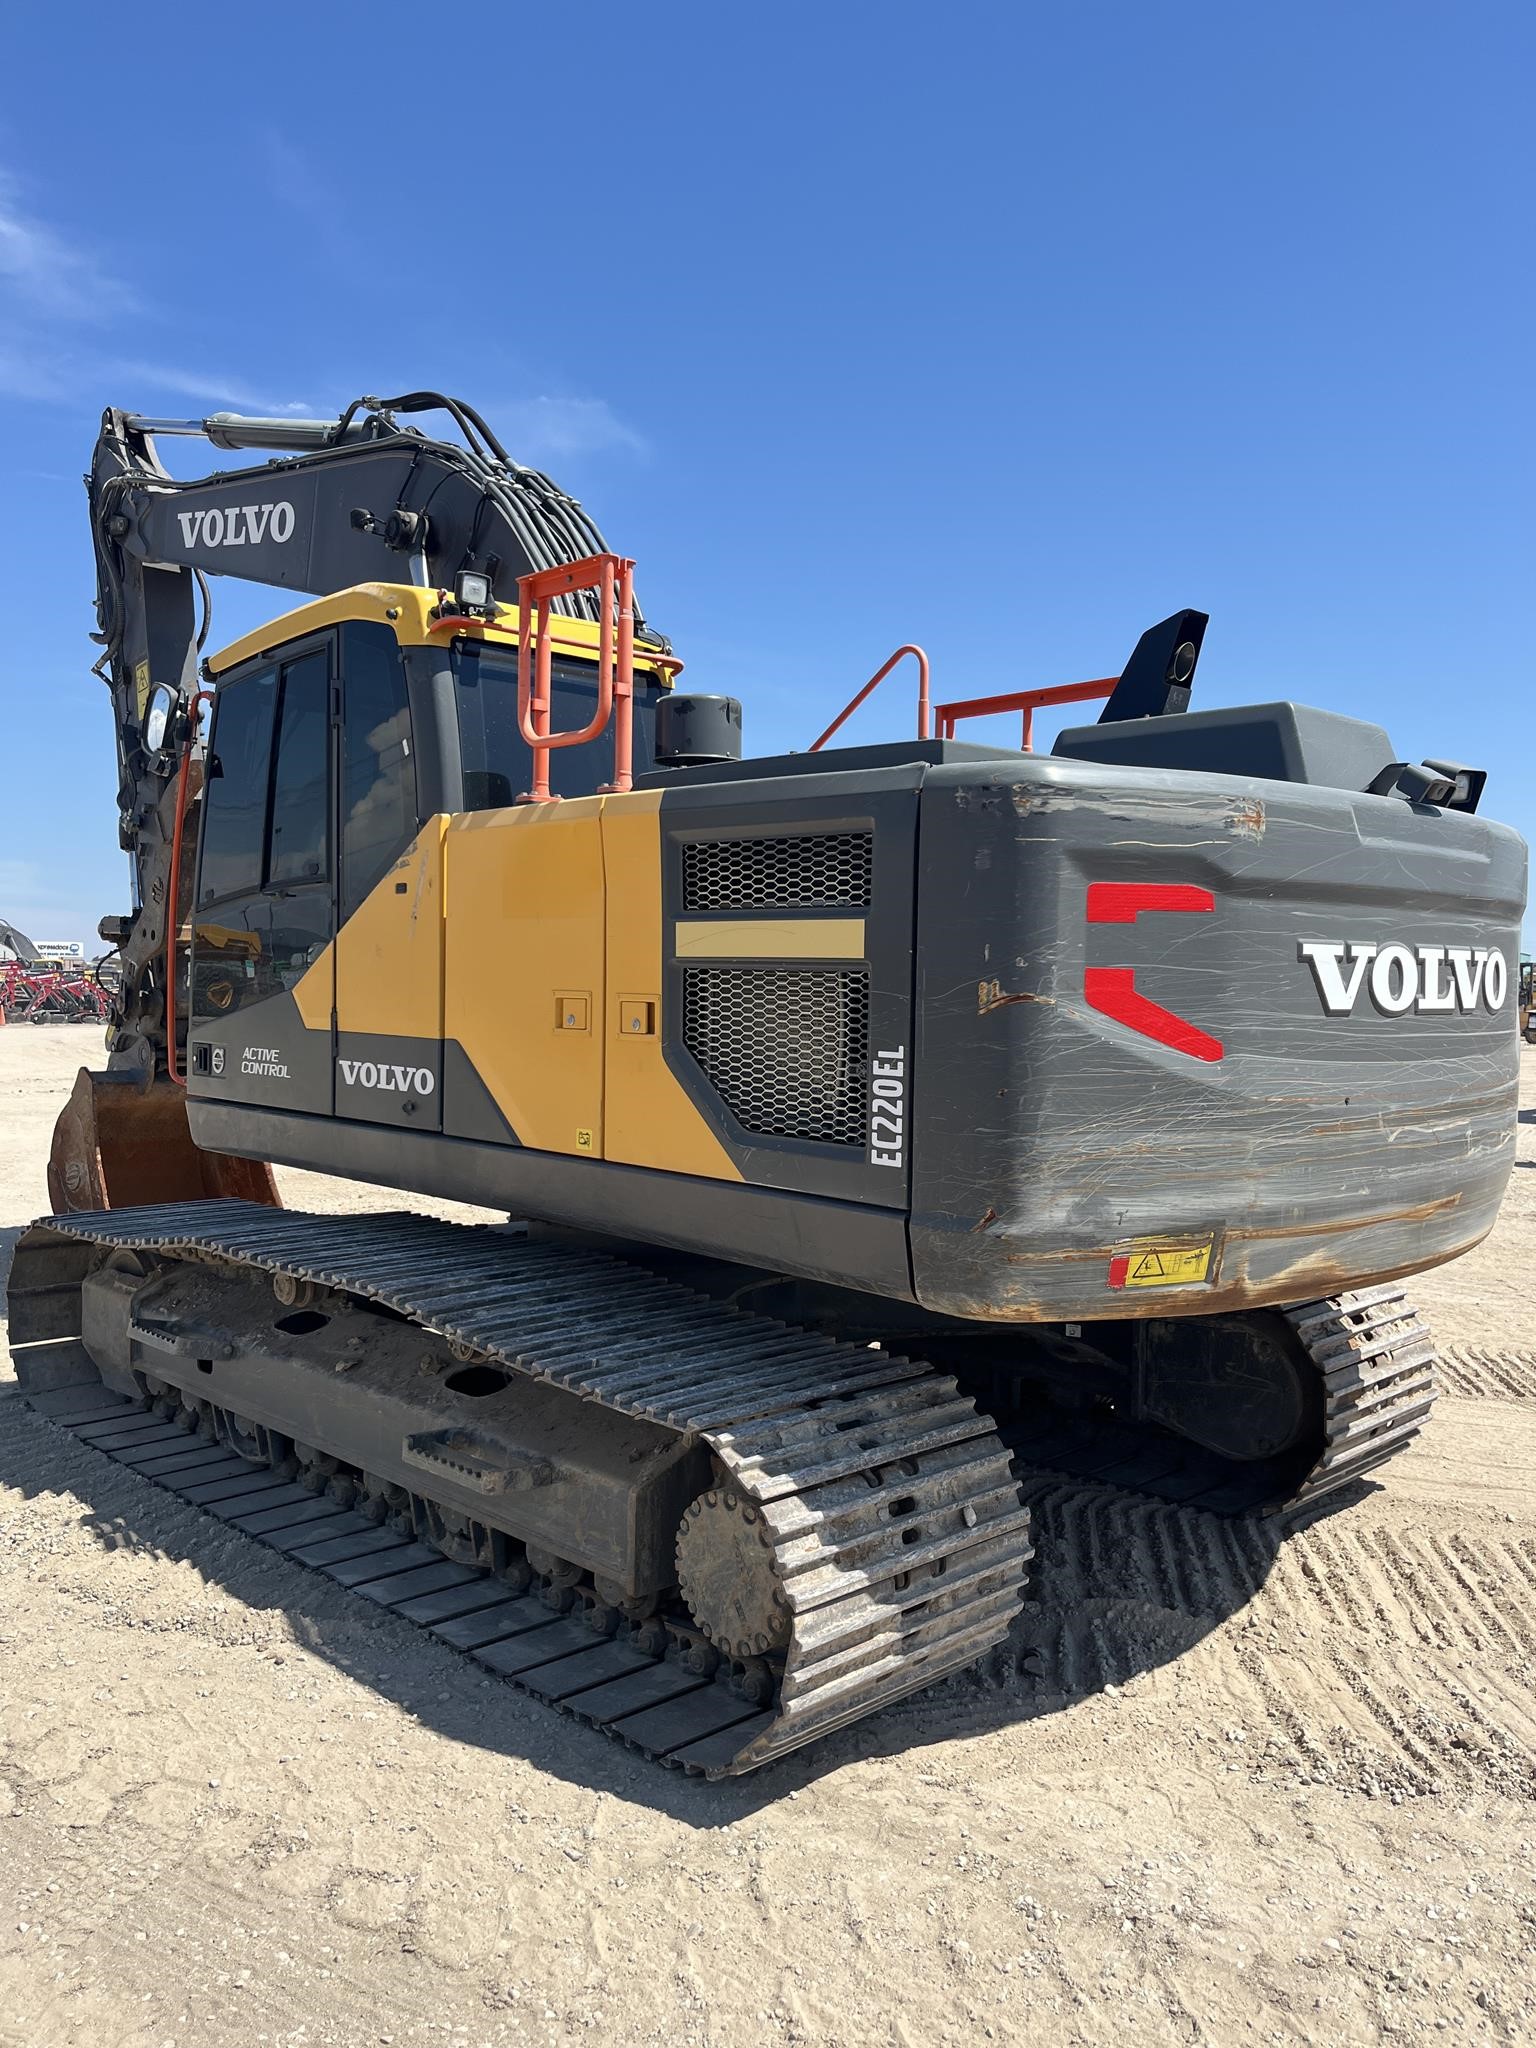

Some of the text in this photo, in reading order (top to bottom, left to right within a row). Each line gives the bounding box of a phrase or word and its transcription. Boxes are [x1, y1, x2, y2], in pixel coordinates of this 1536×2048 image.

[177, 501, 296, 549] VOLVO
[1298, 939, 1508, 1017] VOLVO
[241, 1061, 291, 1079] CONTROL
[242, 1047, 280, 1062] ACTIVE
[338, 1059, 435, 1096] VOLVO
[870, 1045, 905, 1168] EC220EL
